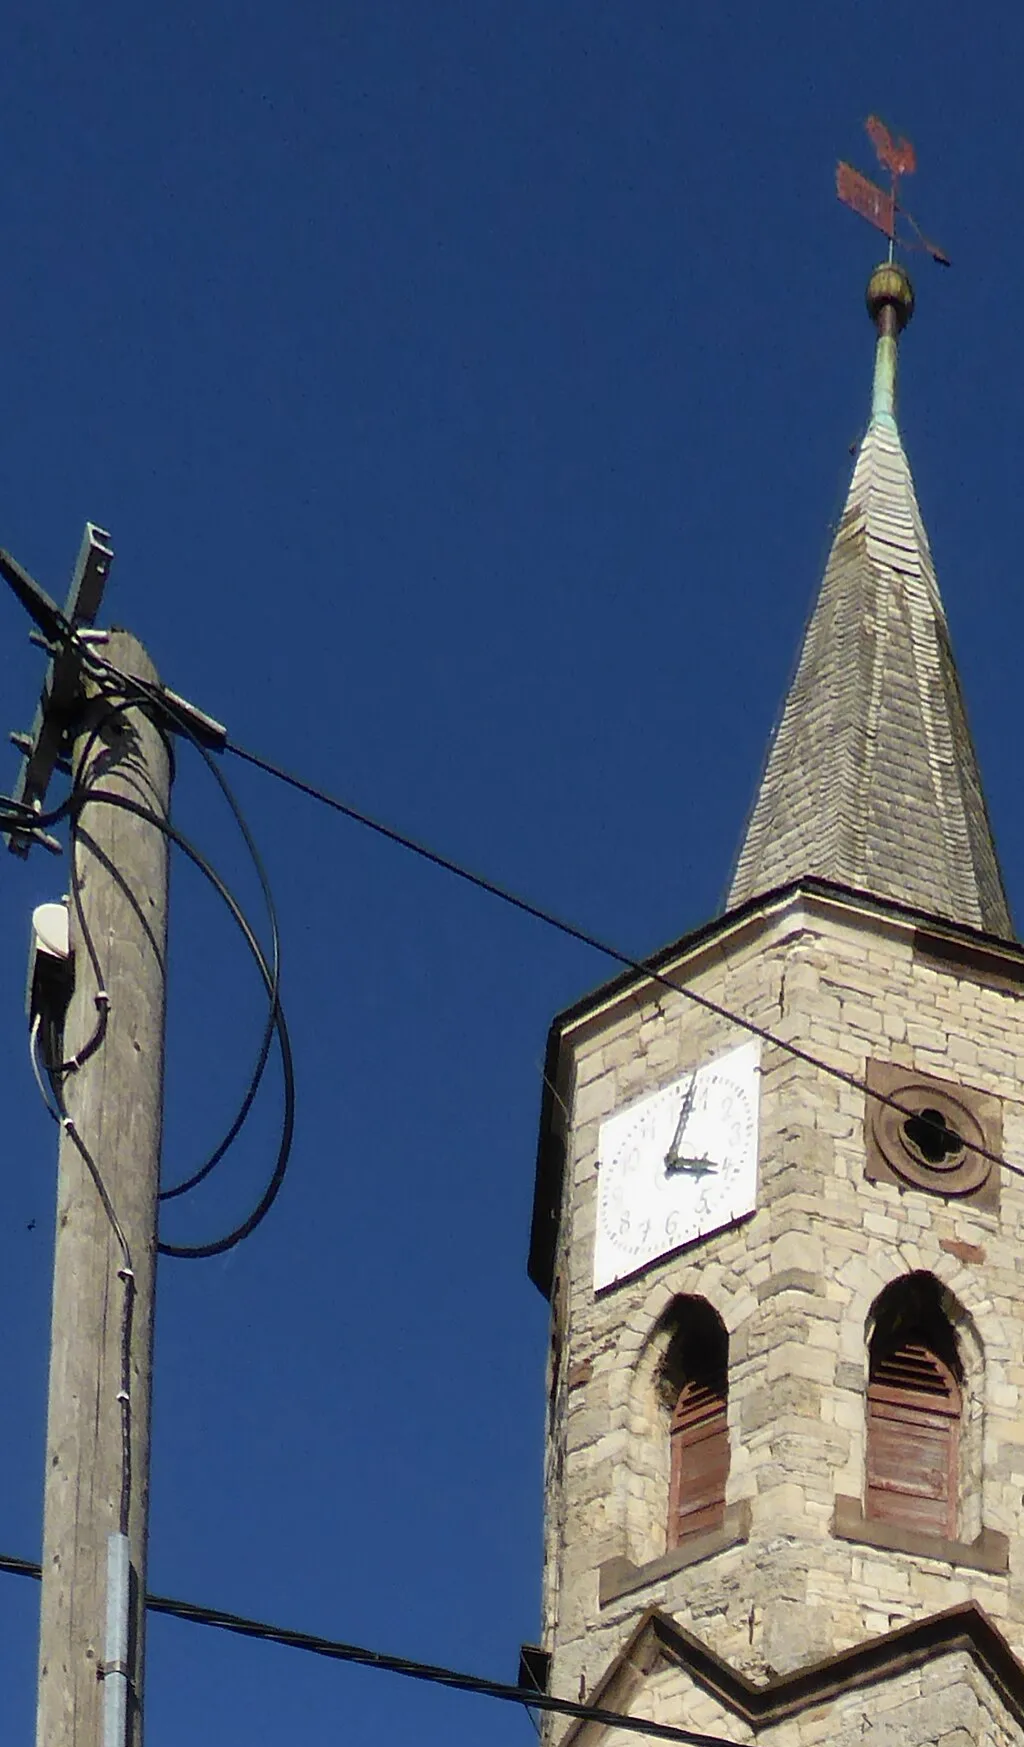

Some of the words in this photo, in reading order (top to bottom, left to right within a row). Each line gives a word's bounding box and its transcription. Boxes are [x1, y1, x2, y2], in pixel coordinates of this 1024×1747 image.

[721, 1096, 734, 1122] 2
[729, 1121, 741, 1147] 3
[722, 1156, 735, 1180] 4
[694, 1187, 712, 1215] 5
[619, 1210, 631, 1236] 8
[638, 1217, 652, 1244] 7
[664, 1209, 680, 1236] 6
